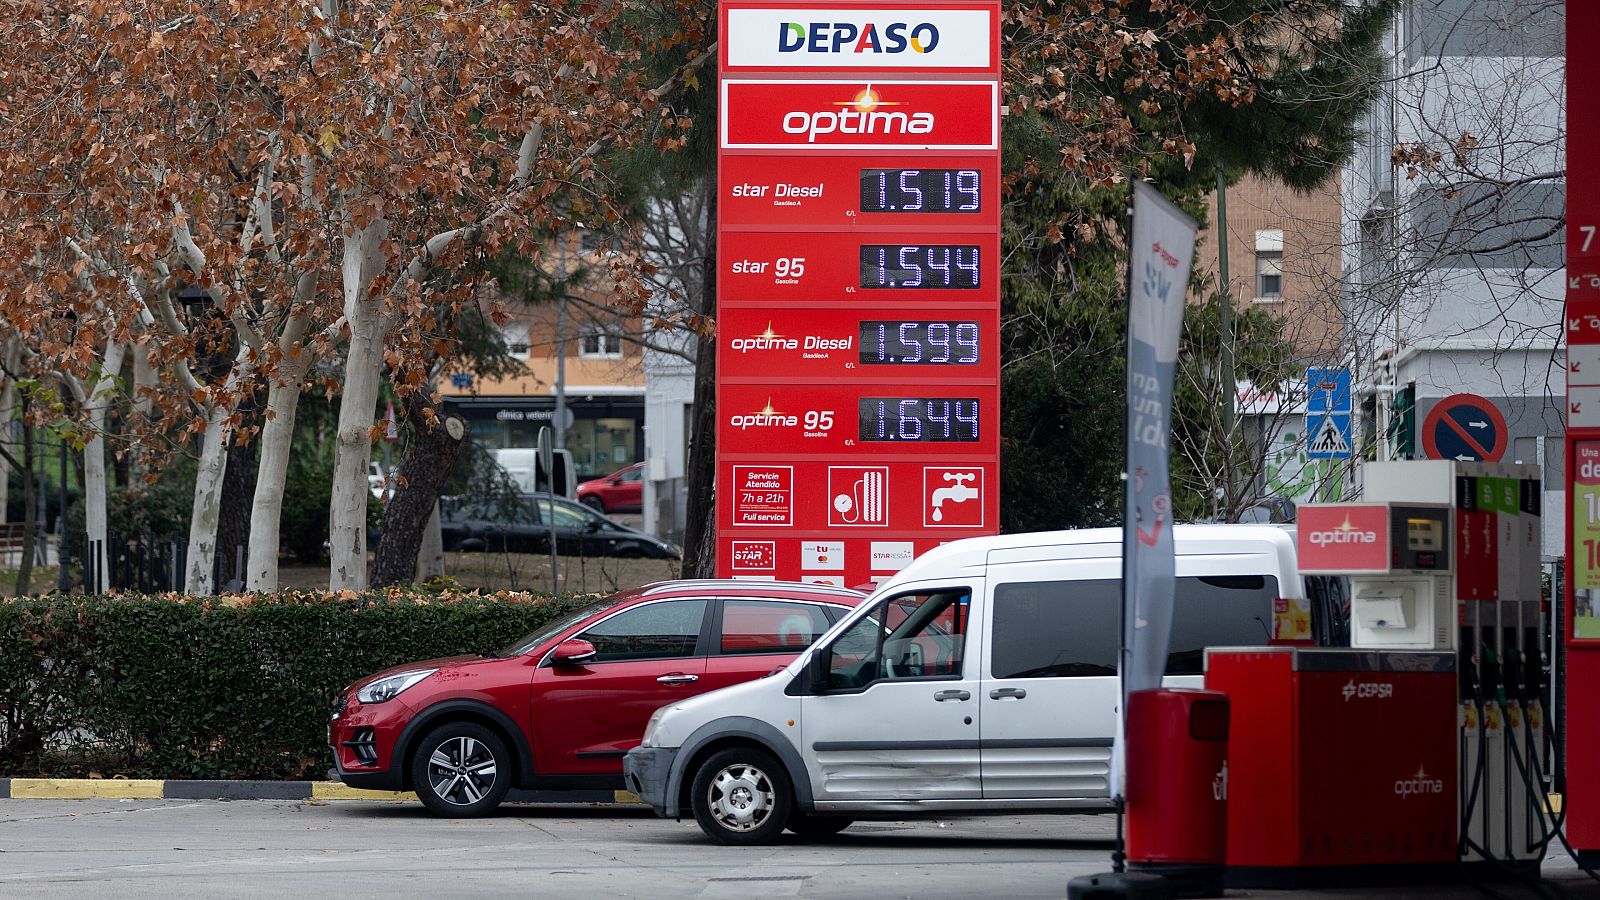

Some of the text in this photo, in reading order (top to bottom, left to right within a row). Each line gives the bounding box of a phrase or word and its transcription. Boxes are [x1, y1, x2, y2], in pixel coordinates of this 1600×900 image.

[778, 22, 940, 54] DEPASO
[782, 107, 935, 143] optima
[732, 183, 824, 197] star Diesel
[879, 170, 979, 210] 1.519
[1579, 226, 1597, 252] 7
[732, 258, 805, 277] star 95
[879, 247, 979, 287] 1.544
[731, 335, 852, 353] optima Diesel
[878, 323, 978, 363] 1.599
[730, 411, 834, 430] optima 95
[878, 399, 978, 439] 1.644
[1582, 448, 1599, 458] Una
[745, 480, 780, 488] Atendido
[748, 472, 779, 480] Servicio
[742, 493, 785, 503] 7h a 21h
[743, 513, 786, 521] Full service
[1309, 529, 1377, 548] optima
[734, 550, 763, 560] STAR
[816, 545, 829, 553] tu
[1394, 777, 1443, 799] optima
